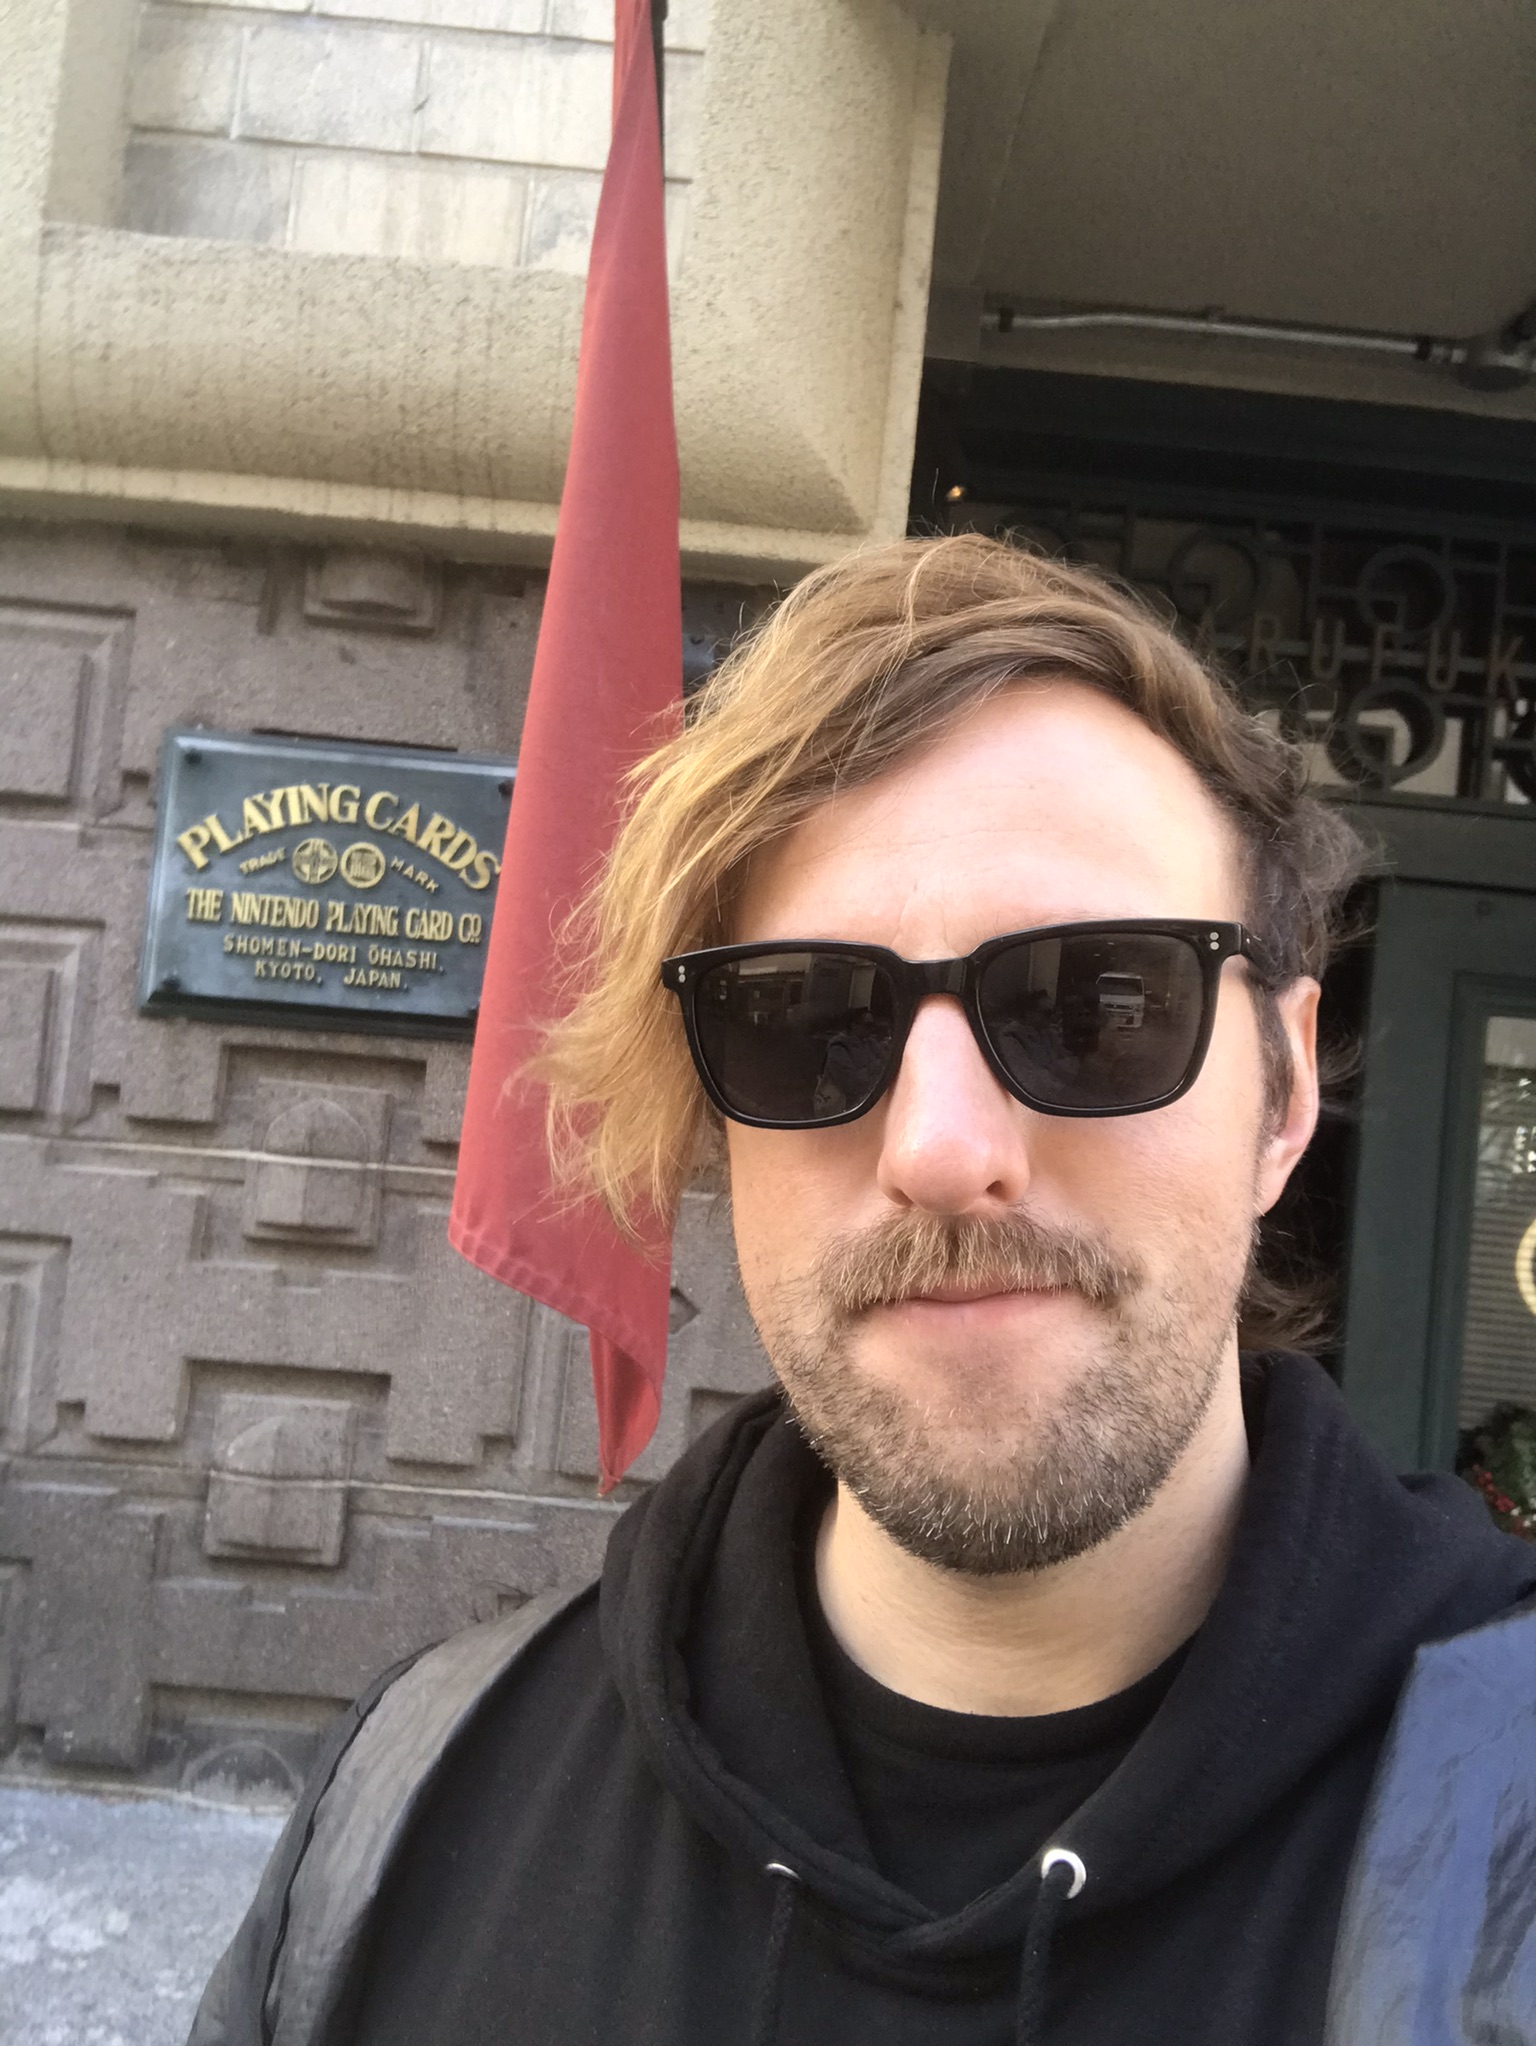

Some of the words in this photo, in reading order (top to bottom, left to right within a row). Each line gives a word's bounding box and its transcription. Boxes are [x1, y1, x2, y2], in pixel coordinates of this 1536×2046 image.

[176, 782, 361, 870] PLAYING
[364, 790, 502, 890] CARDS
[239, 847, 286, 875] TRADE
[390, 856, 439, 893] MARK
[186, 887, 224, 922] THE
[230, 891, 319, 929] NINTENDO
[325, 899, 399, 937] PLAYING
[405, 907, 453, 942] CARD
[223, 932, 356, 963] SHOMEN-DORI
